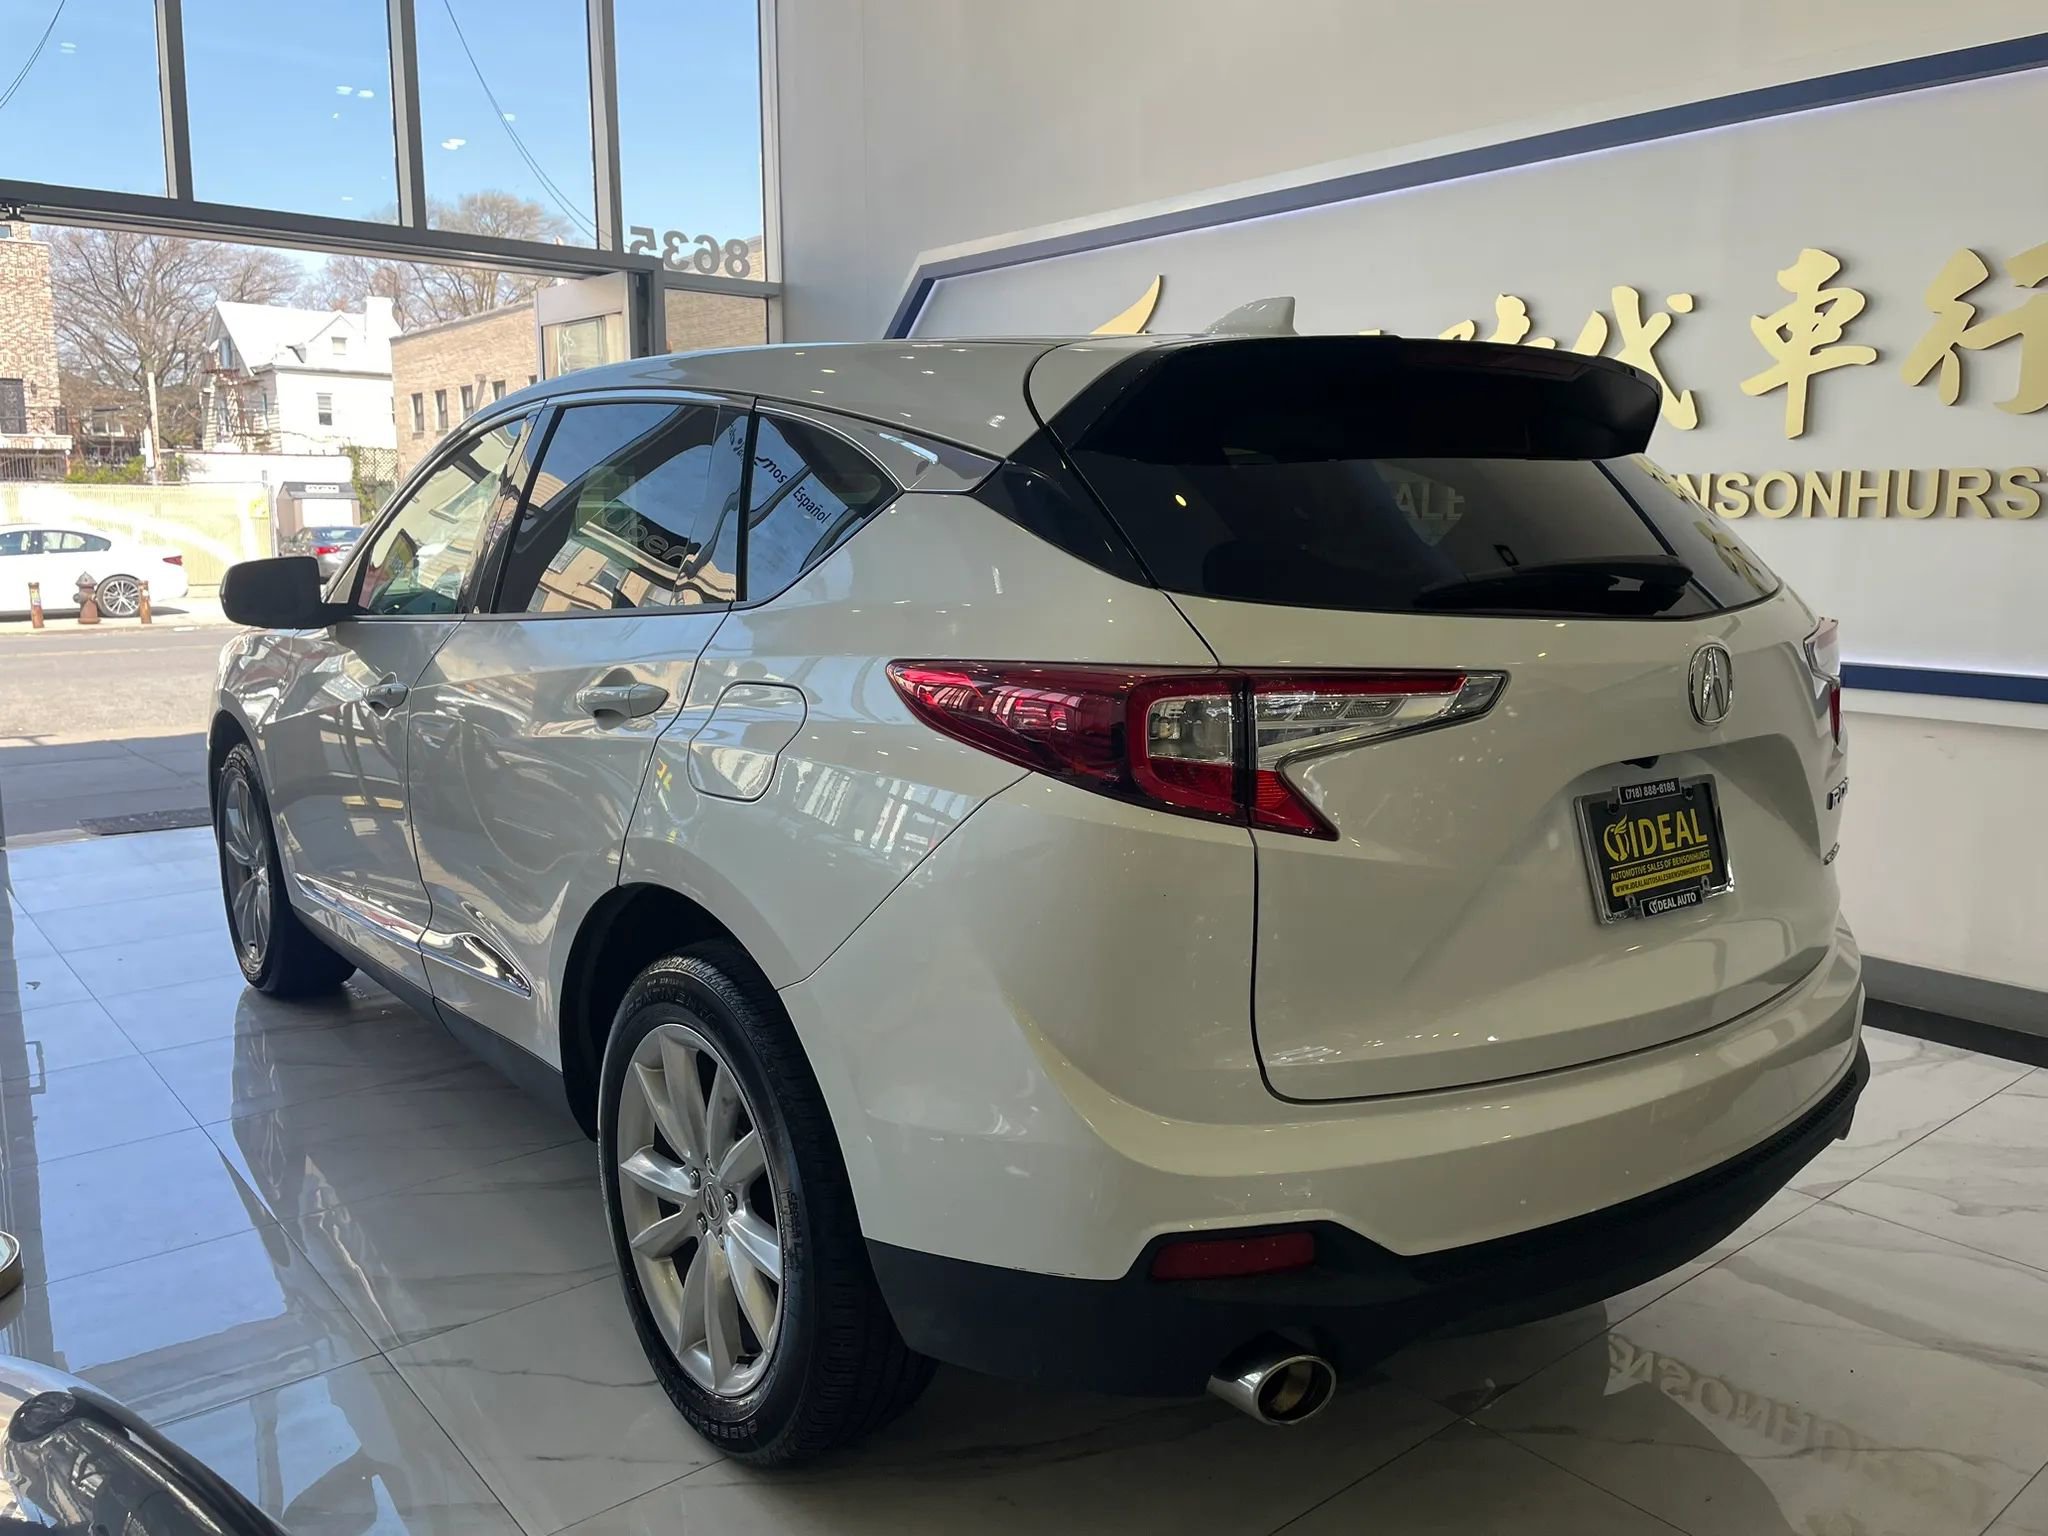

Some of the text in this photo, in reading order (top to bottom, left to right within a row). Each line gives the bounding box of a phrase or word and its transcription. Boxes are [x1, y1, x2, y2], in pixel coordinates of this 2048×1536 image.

[793, 485, 831, 525] Español
[1671, 466, 2046, 520] NSONHURS
[1625, 781, 1676, 800] (718) 888-8188
[1628, 808, 1708, 858] IDEAL
[1611, 849, 1711, 881] AUTOMOTIVE SALES OF BENSONHURST
[1677, 892, 1697, 907] AUTO
